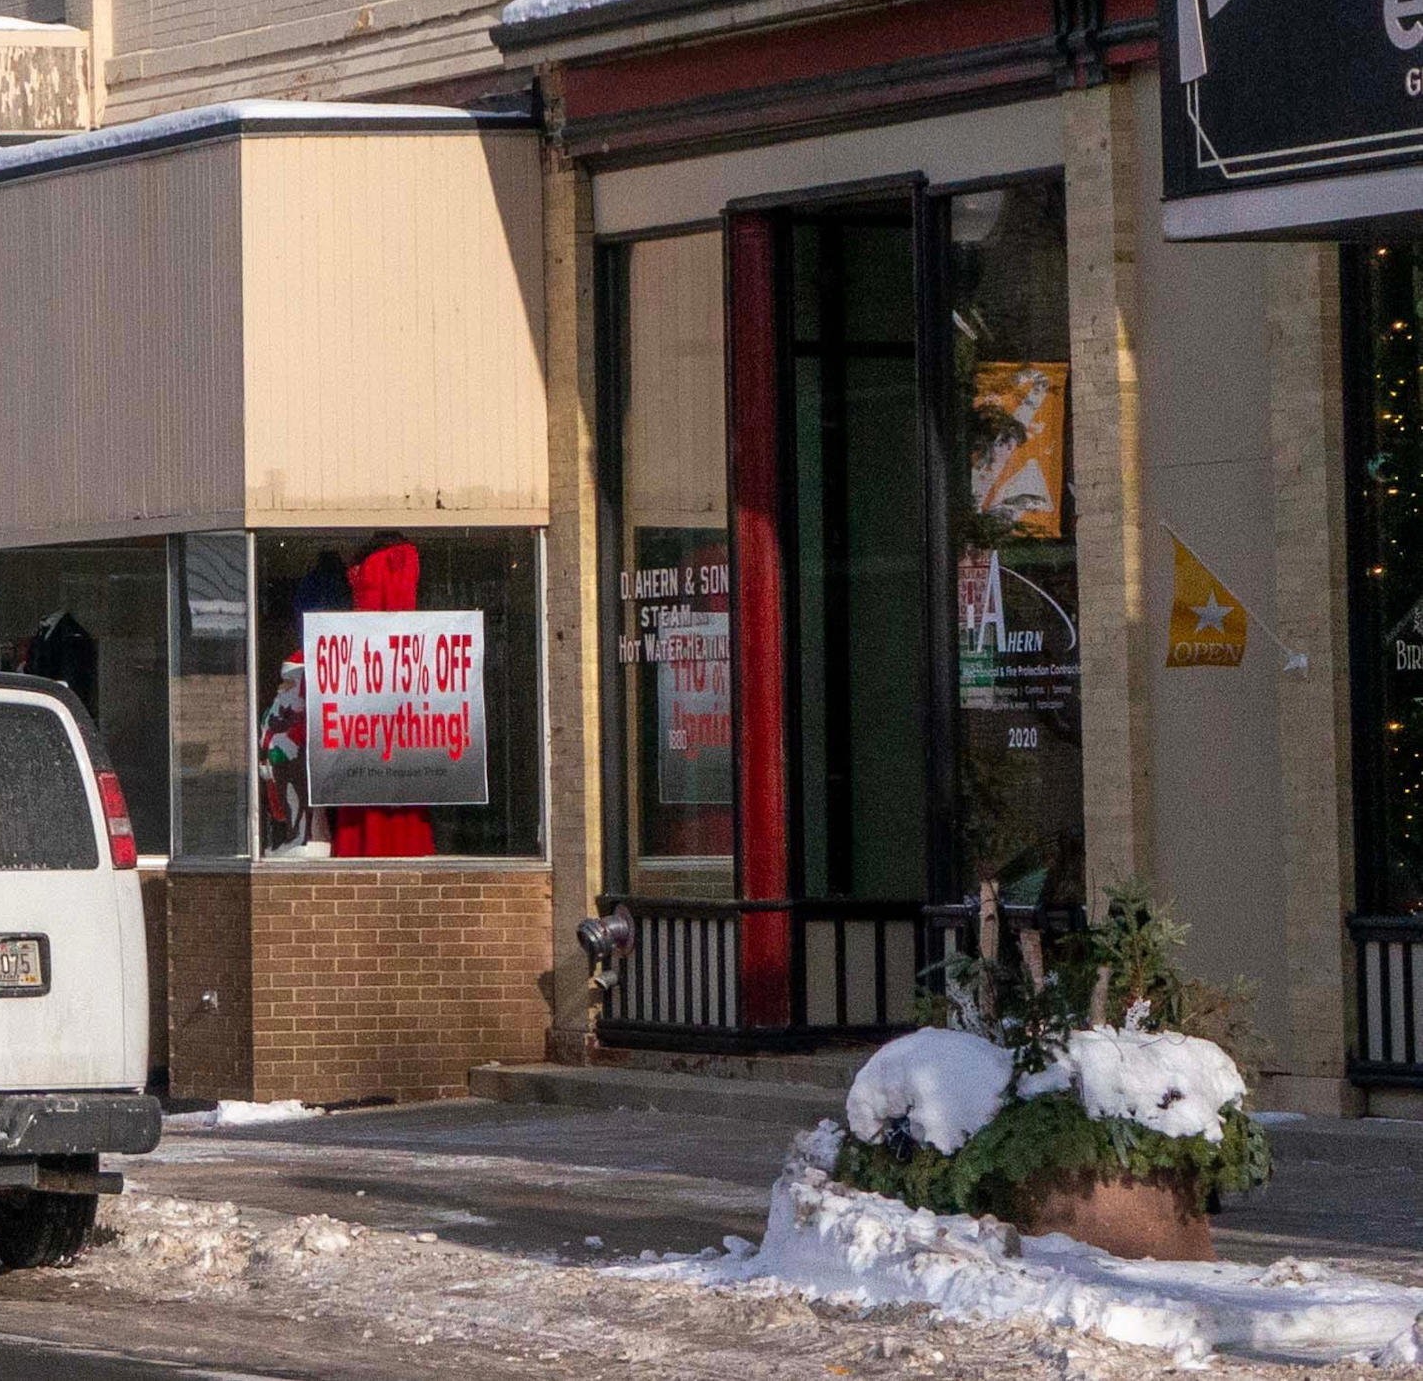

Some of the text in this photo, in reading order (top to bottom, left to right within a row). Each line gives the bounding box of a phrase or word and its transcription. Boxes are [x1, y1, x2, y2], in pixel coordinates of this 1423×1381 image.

[635, 567, 679, 599] AHERN
[684, 566, 695, 596] &
[640, 604, 692, 627] STEAM
[316, 633, 472, 696] 60% to 75% OFF
[1173, 641, 1243, 662] OPEN
[1395, 639, 1423, 670] BIR
[322, 701, 471, 762] Everything!
[1008, 727, 1038, 749] 2020
